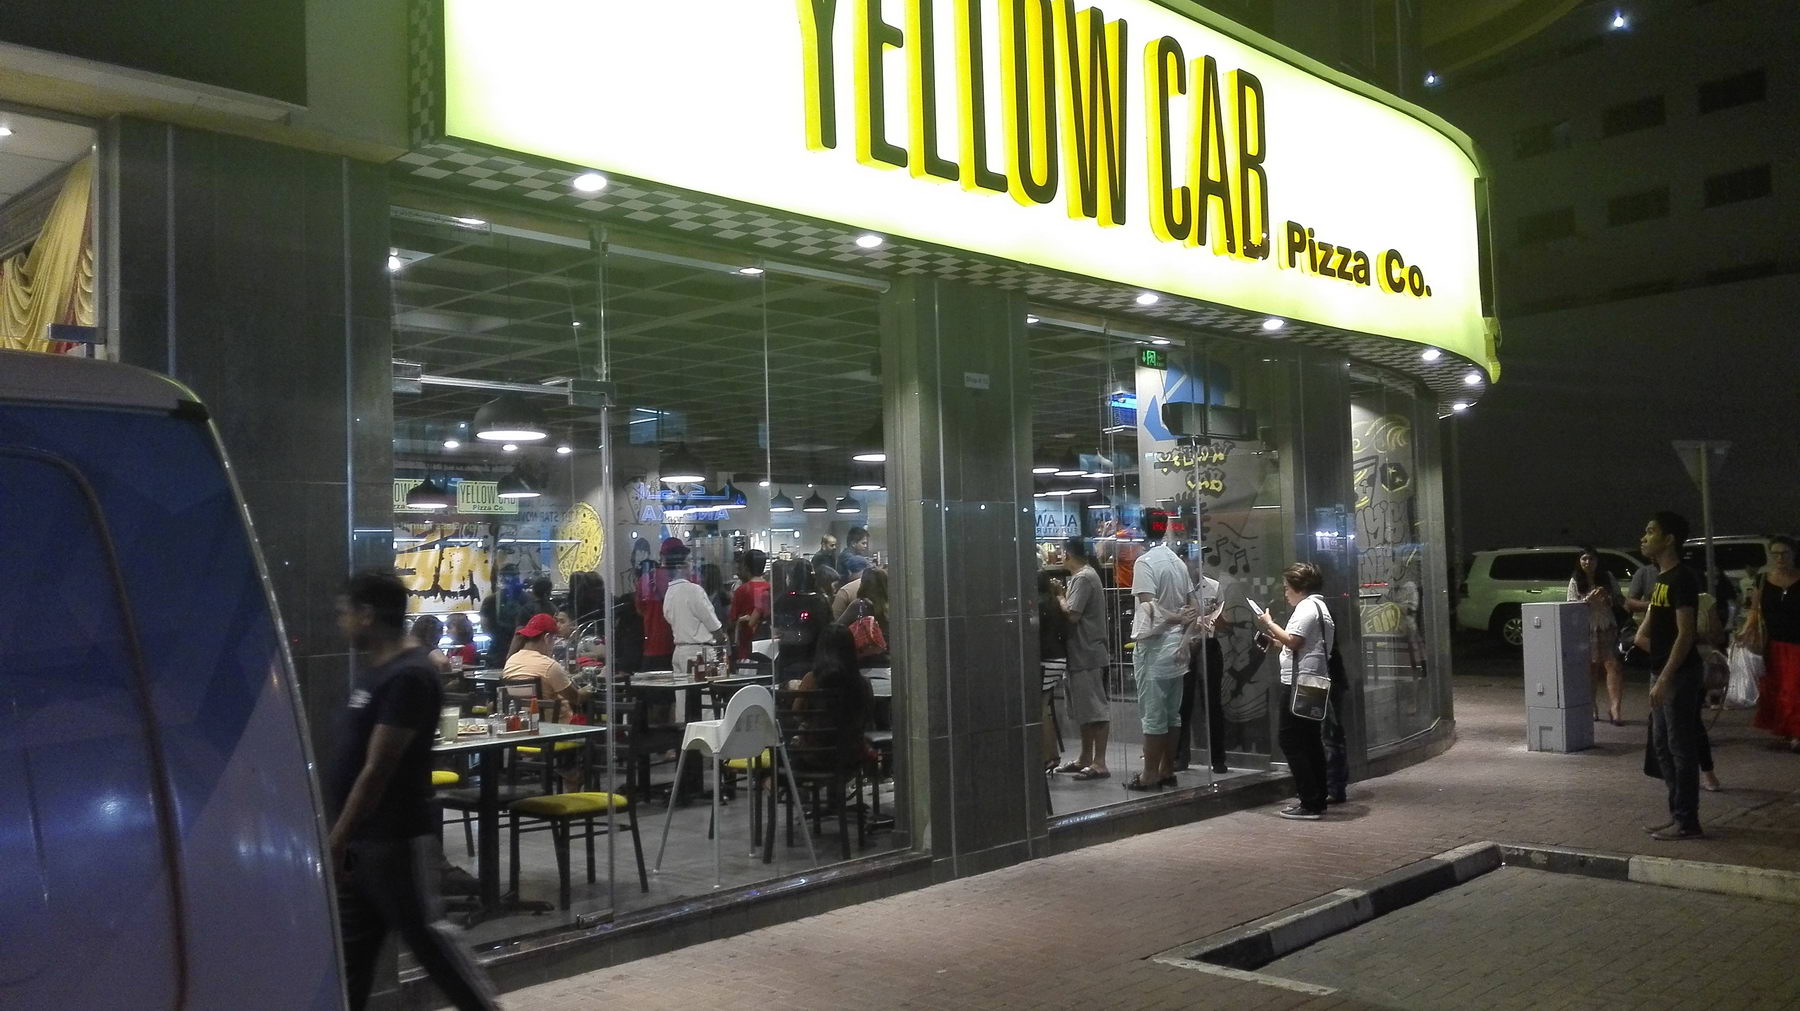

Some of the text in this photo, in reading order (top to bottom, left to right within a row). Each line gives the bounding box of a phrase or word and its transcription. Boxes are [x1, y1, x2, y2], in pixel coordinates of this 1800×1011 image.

[797, 0, 1270, 261] YELLOW CAB
[1280, 220, 1432, 298] Pizza Co.
[460, 484, 497, 504] YELLOW
